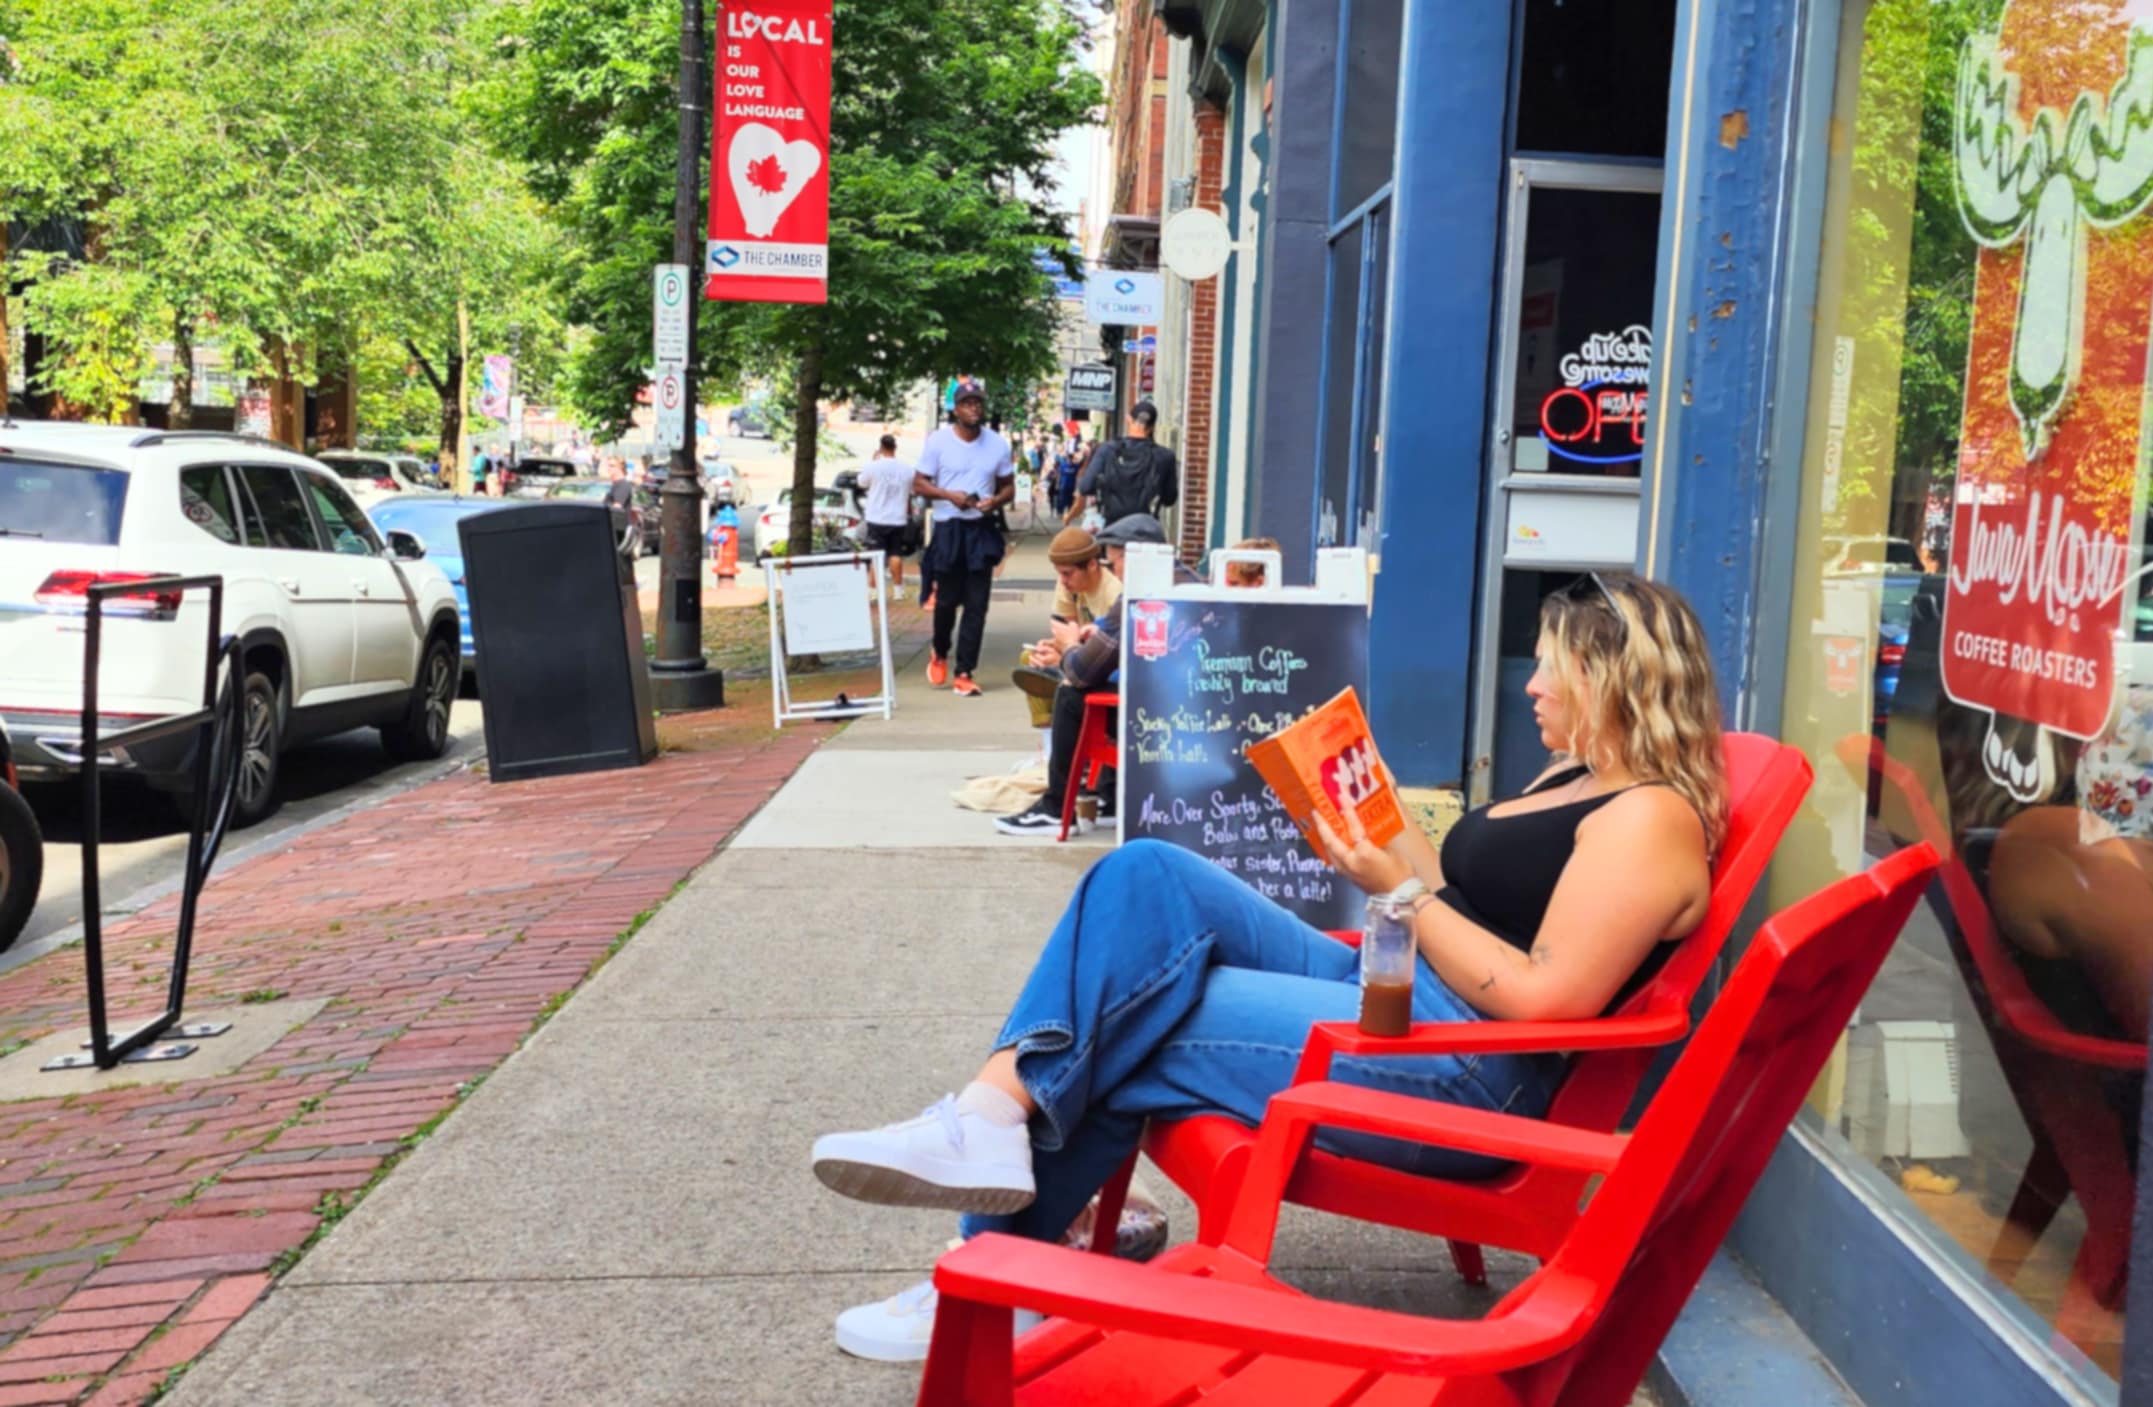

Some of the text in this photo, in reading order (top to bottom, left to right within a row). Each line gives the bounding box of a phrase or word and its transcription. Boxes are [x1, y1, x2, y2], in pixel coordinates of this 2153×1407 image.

[728, 11, 824, 45] LOCAL
[727, 45, 742, 58] IS
[726, 64, 760, 79] OUR
[726, 83, 765, 99] LOVE
[725, 103, 805, 121] LANGUAGE
[744, 250, 823, 268] THE CHAMBER
[1071, 371, 1112, 389] MNP
[1541, 388, 1647, 444] OPE
[1954, 629, 2098, 690] COFFEE ROASTERS
[1284, 883, 1296, 898] a
